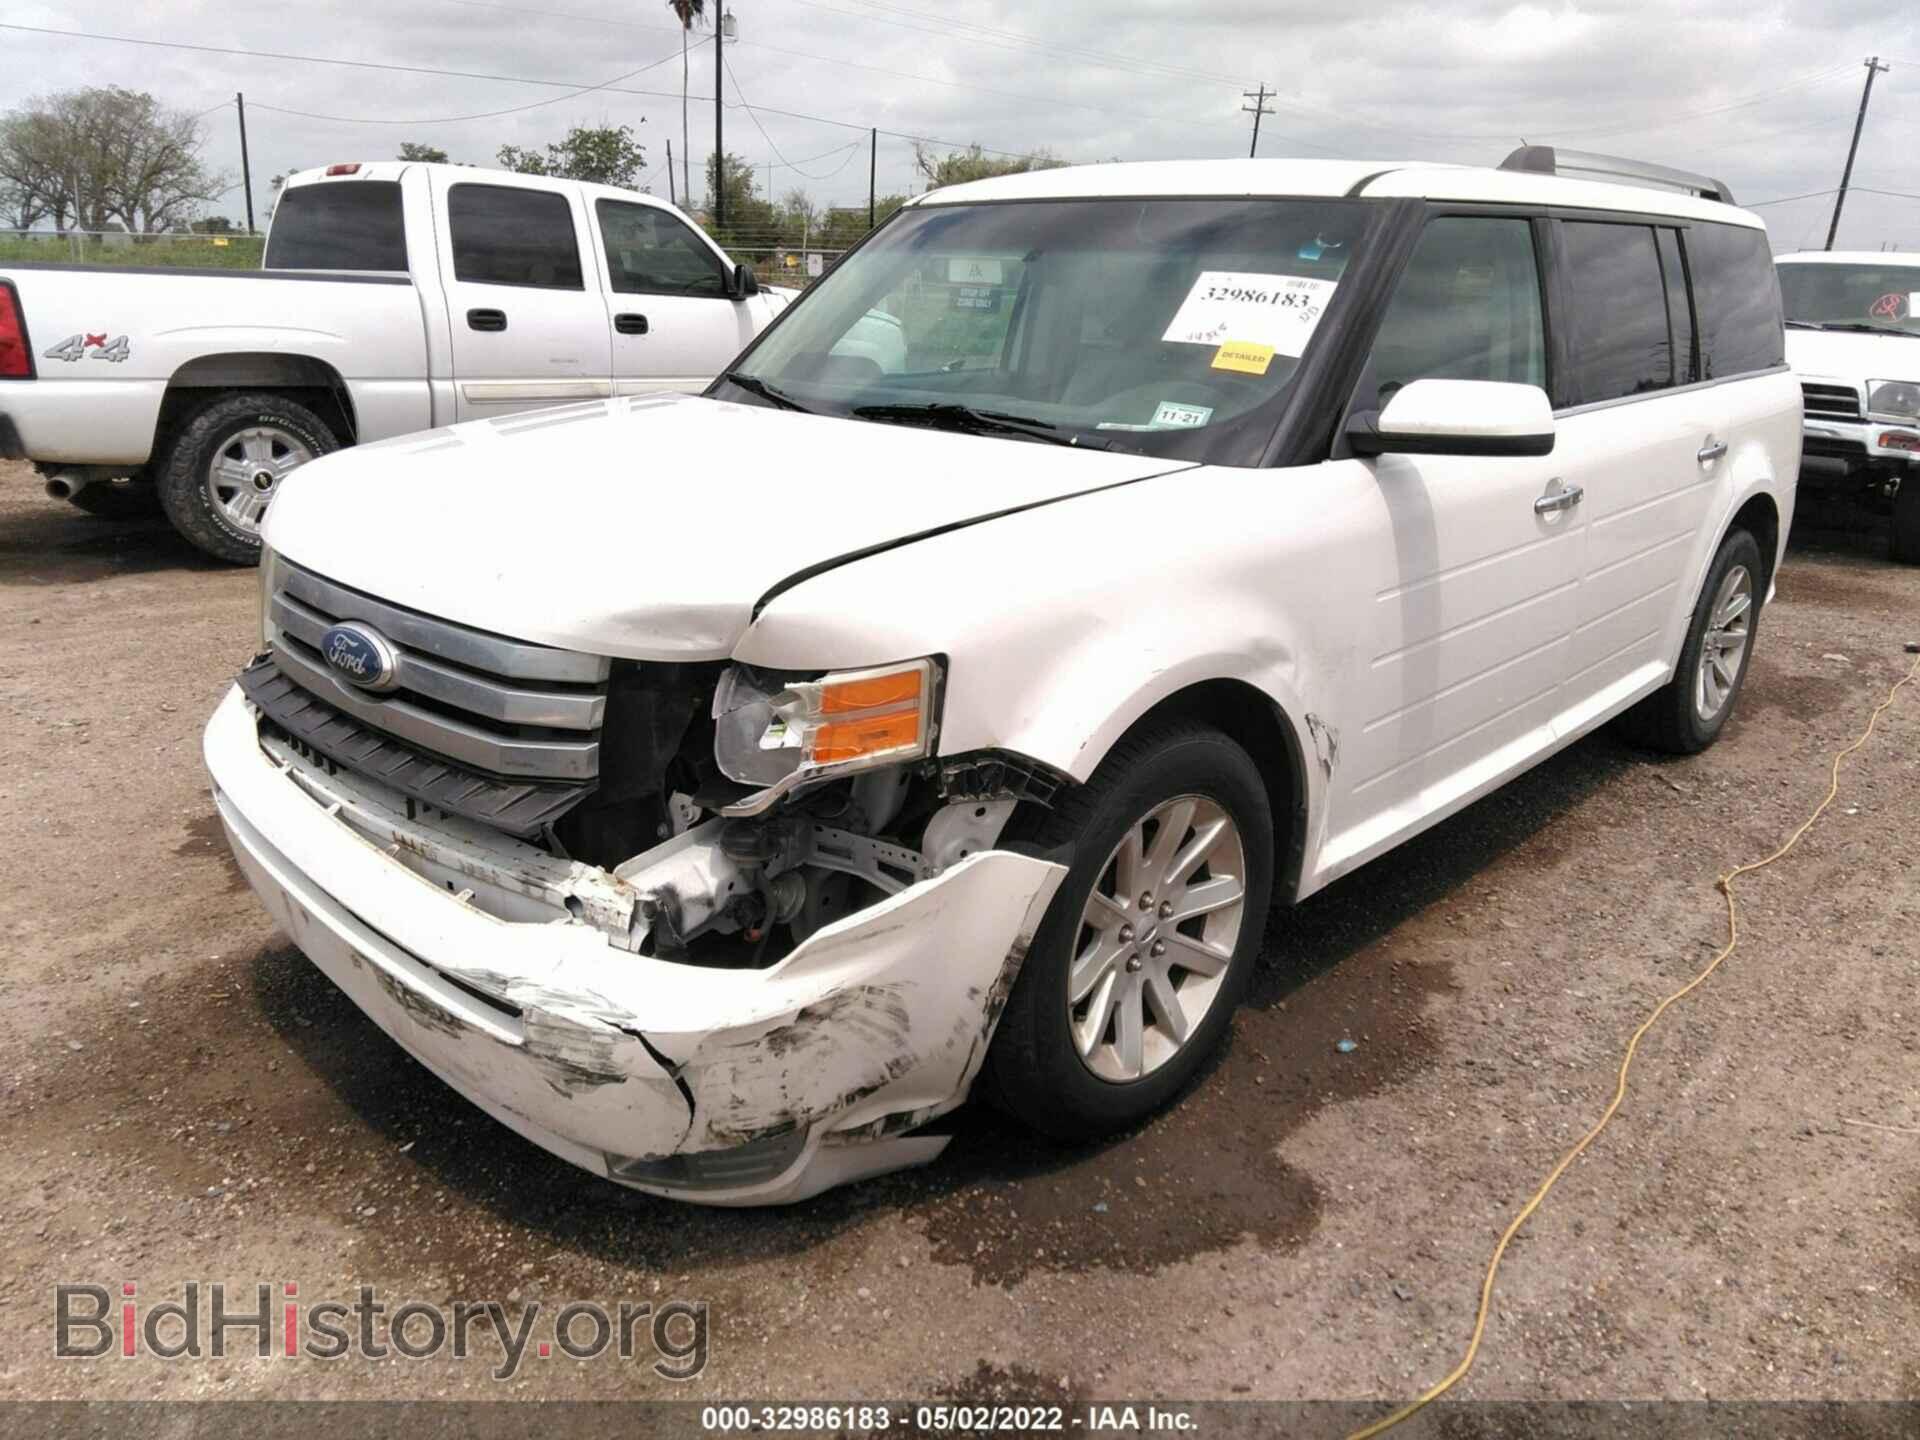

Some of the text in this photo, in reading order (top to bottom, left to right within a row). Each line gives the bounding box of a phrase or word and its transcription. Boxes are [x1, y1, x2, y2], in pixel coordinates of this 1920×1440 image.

[1200, 287, 1310, 307] 32986183
[1221, 351, 1266, 362] DETAILED
[1162, 411, 1200, 424] 11-21
[328, 633, 368, 674] Ford
